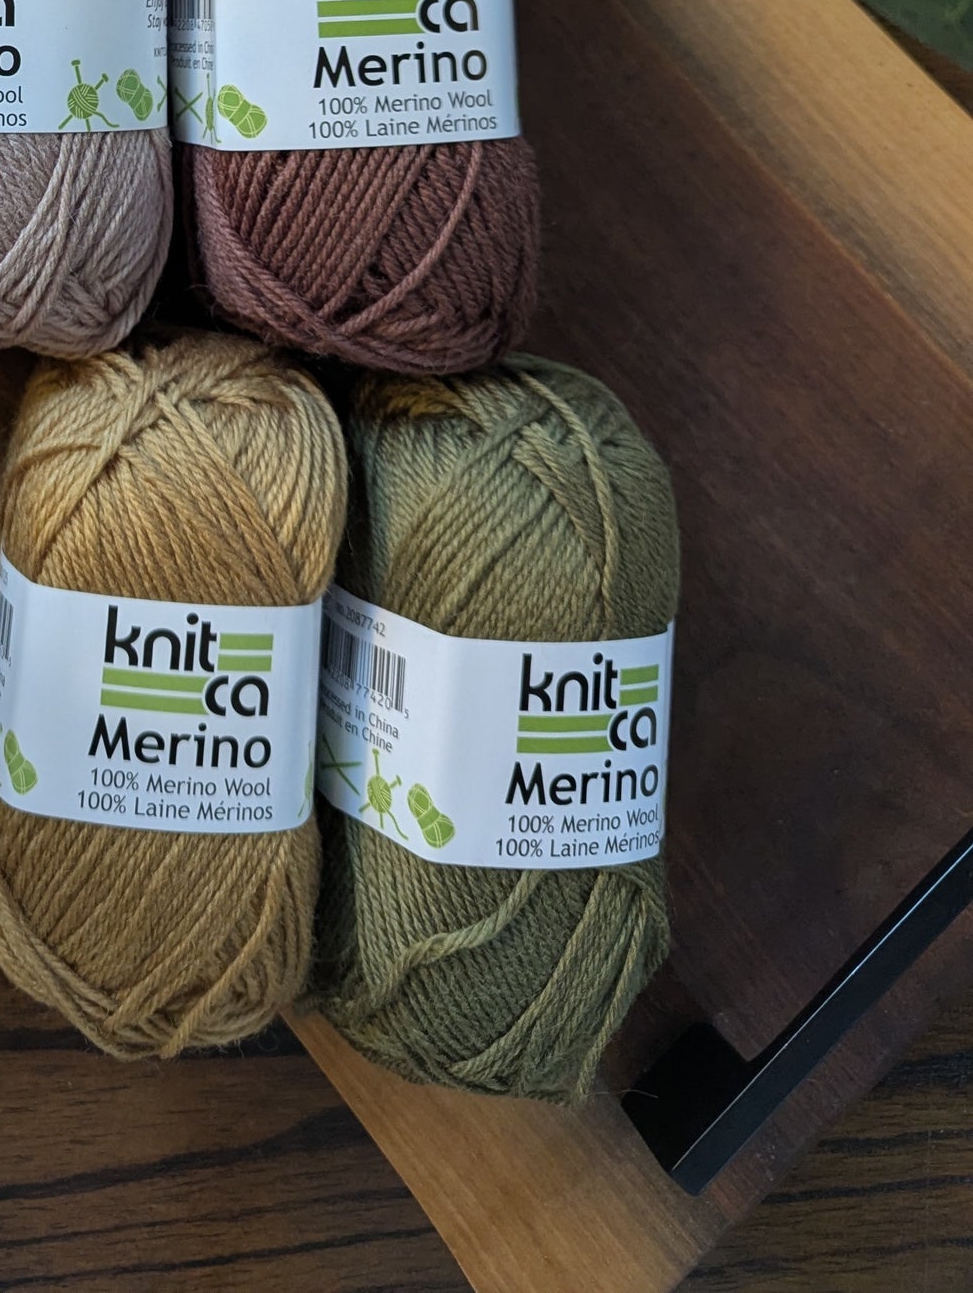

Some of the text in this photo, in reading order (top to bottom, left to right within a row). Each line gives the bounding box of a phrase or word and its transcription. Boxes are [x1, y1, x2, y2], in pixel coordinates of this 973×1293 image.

[313, 41, 487, 88] Merino
[318, 89, 493, 116] 100% Merino Wool
[309, 112, 497, 139] 100% Laine Mérinos
[104, 604, 217, 673] knit
[205, 675, 269, 717] ca
[519, 652, 618, 712] knit
[355, 683, 393, 710] 77420
[404, 709, 410, 719] 5
[345, 722, 358, 736] en
[362, 727, 393, 753] Chine
[355, 706, 365, 721] in
[369, 712, 399, 739] China
[609, 706, 657, 751] ca
[88, 713, 272, 769] Merino
[90, 768, 270, 797] 100% Merino Wool
[505, 759, 659, 806] Merino
[77, 791, 273, 821] 100% Laine Mérinos
[508, 804, 659, 834] 100% Merino Wool
[495, 830, 660, 857] 100% Laine Mérinos
